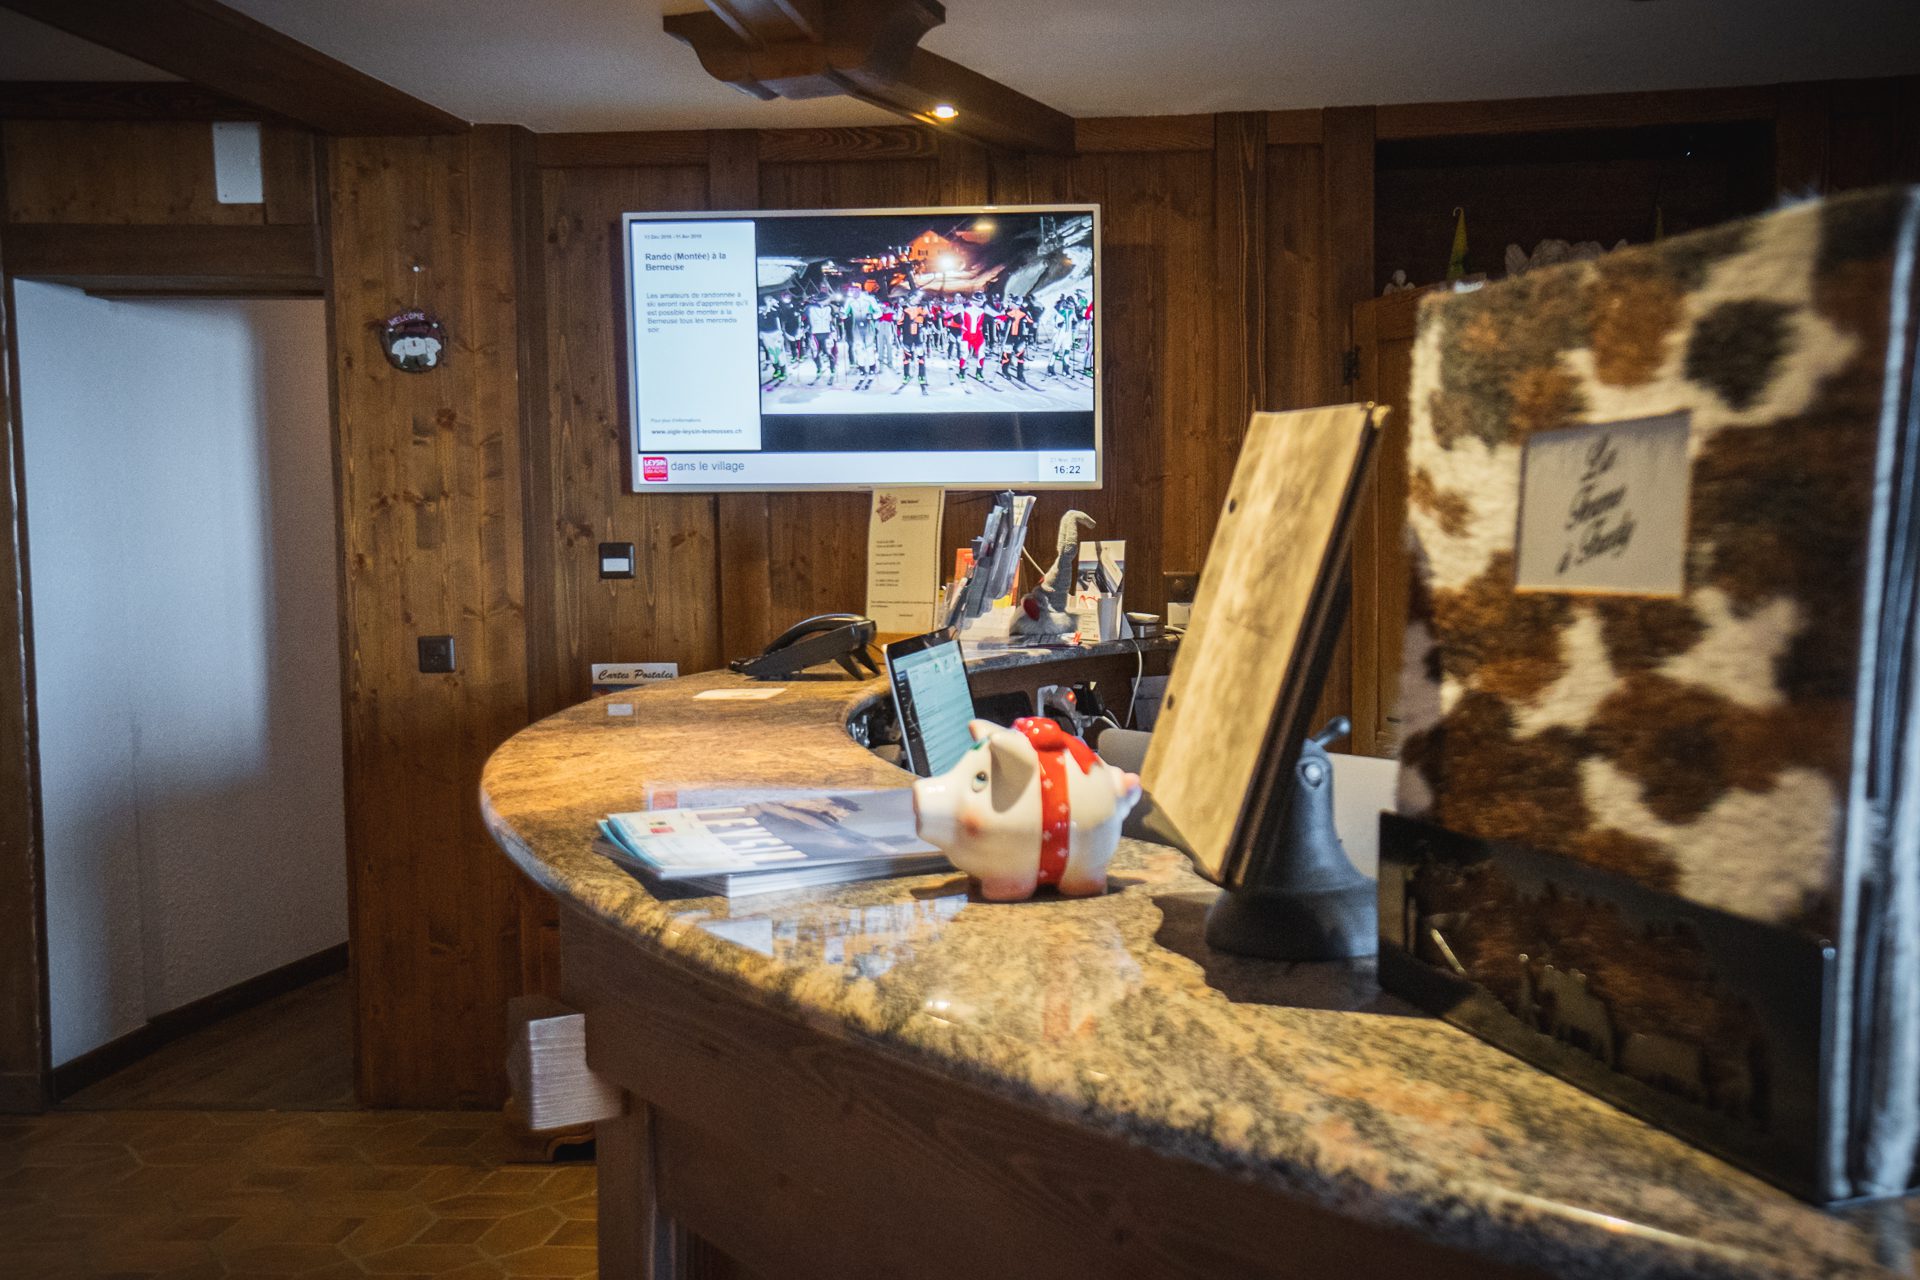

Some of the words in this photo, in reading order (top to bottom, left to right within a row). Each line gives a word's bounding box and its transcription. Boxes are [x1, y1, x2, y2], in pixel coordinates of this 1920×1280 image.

[645, 253, 672, 261] Rando
[674, 252, 710, 261] (Montée)
[712, 252, 717, 260] à
[719, 252, 727, 260] la
[645, 263, 685, 272] Berneuse
[696, 300, 734, 308] d'apprendre
[658, 309, 685, 317] possible
[388, 311, 425, 327] WELCOME
[651, 428, 743, 436] www.aigle-leysin-lesmosses.ch
[670, 461, 696, 471] dans
[699, 461, 709, 471] le
[711, 461, 745, 473] village
[1054, 465, 1081, 474] 16:22
[598, 669, 630, 681] Cartes
[634, 669, 674, 680] Postales
